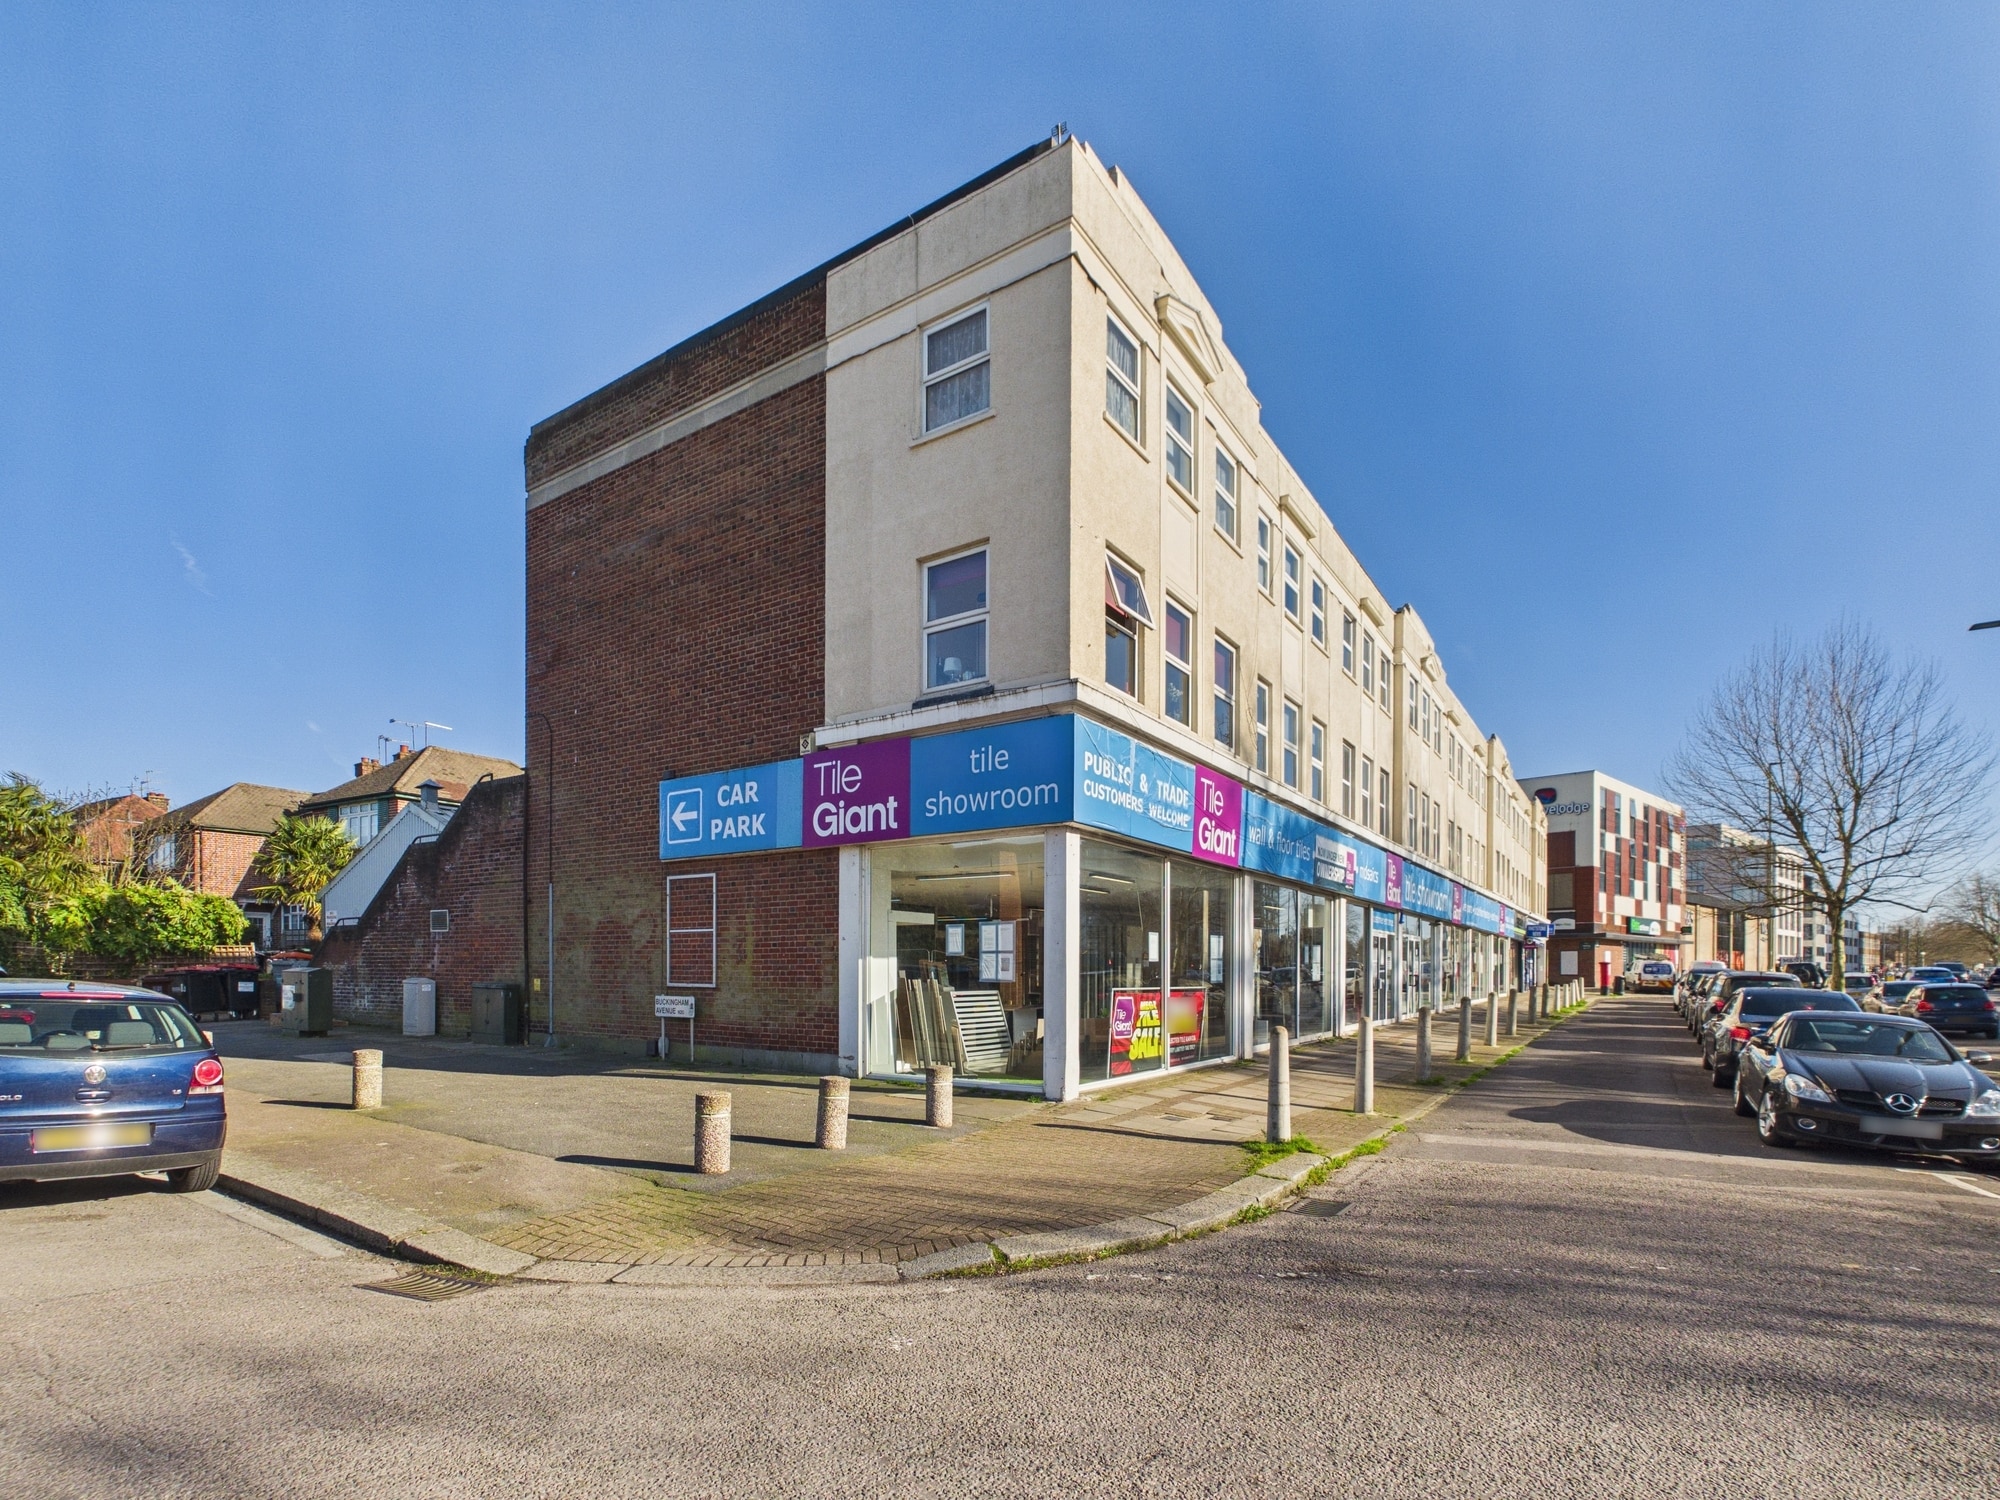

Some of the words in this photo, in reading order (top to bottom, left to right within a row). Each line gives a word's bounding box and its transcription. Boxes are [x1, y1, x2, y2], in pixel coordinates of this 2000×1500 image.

[970, 744, 1009, 774] tile
[813, 760, 862, 796] Tile
[1084, 751, 1132, 786] PUBLIC
[1139, 773, 1148, 794] &
[1156, 780, 1190, 808] TRADE
[717, 781, 759, 807] CAR
[925, 782, 1059, 818] showroom
[1083, 779, 1144, 813] CUSTOMERS
[1149, 802, 1189, 827] WELCOME
[1201, 778, 1224, 817] Tile
[1545, 801, 1590, 817] velodge
[710, 812, 766, 841] PARK
[812, 795, 898, 838] Giant
[1198, 816, 1237, 858] Giant
[1249, 822, 1266, 846] wall
[1268, 828, 1275, 849] &
[1276, 831, 1294, 855] floor
[1296, 841, 1311, 862] tiles
[1316, 861, 1345, 884] OWNERSHIP
[1387, 859, 1397, 880] Tile
[1387, 881, 1401, 904] Giant
[1405, 874, 1416, 904] tile
[1417, 878, 1449, 912] showroom
[655, 998, 689, 1006] BUCKINGHAM
[656, 1007, 677, 1015] AVENUE
[1116, 1009, 1127, 1020] Tile
[1115, 1021, 1132, 1032] Giant
[1128, 1026, 1162, 1061] SALE
